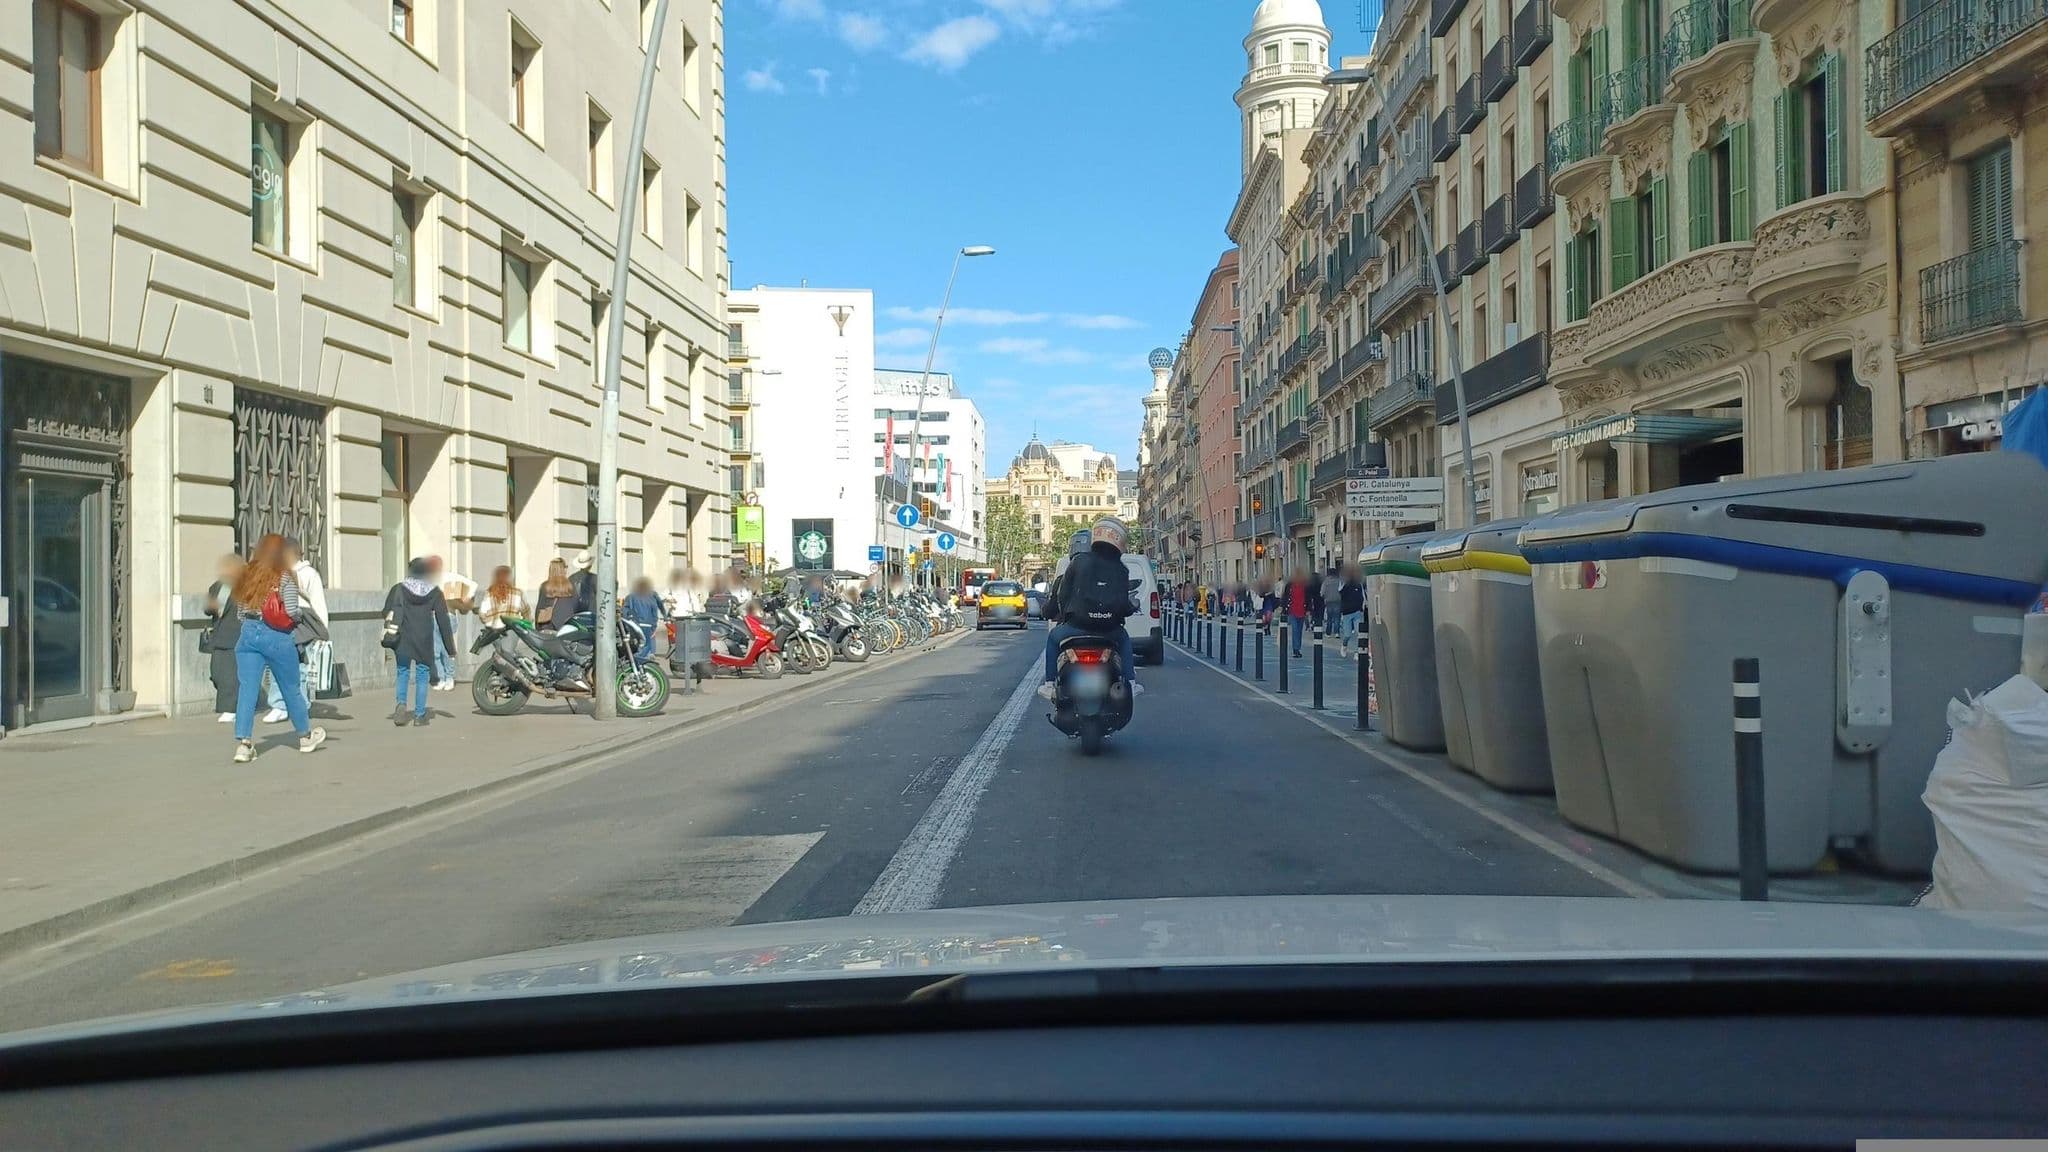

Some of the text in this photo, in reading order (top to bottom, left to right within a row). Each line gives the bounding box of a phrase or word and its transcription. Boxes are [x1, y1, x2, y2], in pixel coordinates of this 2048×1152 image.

[1551, 416, 1636, 453] HOTEL CATALONIA RAMBLAS
[1371, 480, 1411, 489] Catalunya
[1359, 493, 1408, 503] C. Fontanella
[1359, 509, 1404, 518] Via Laietana
